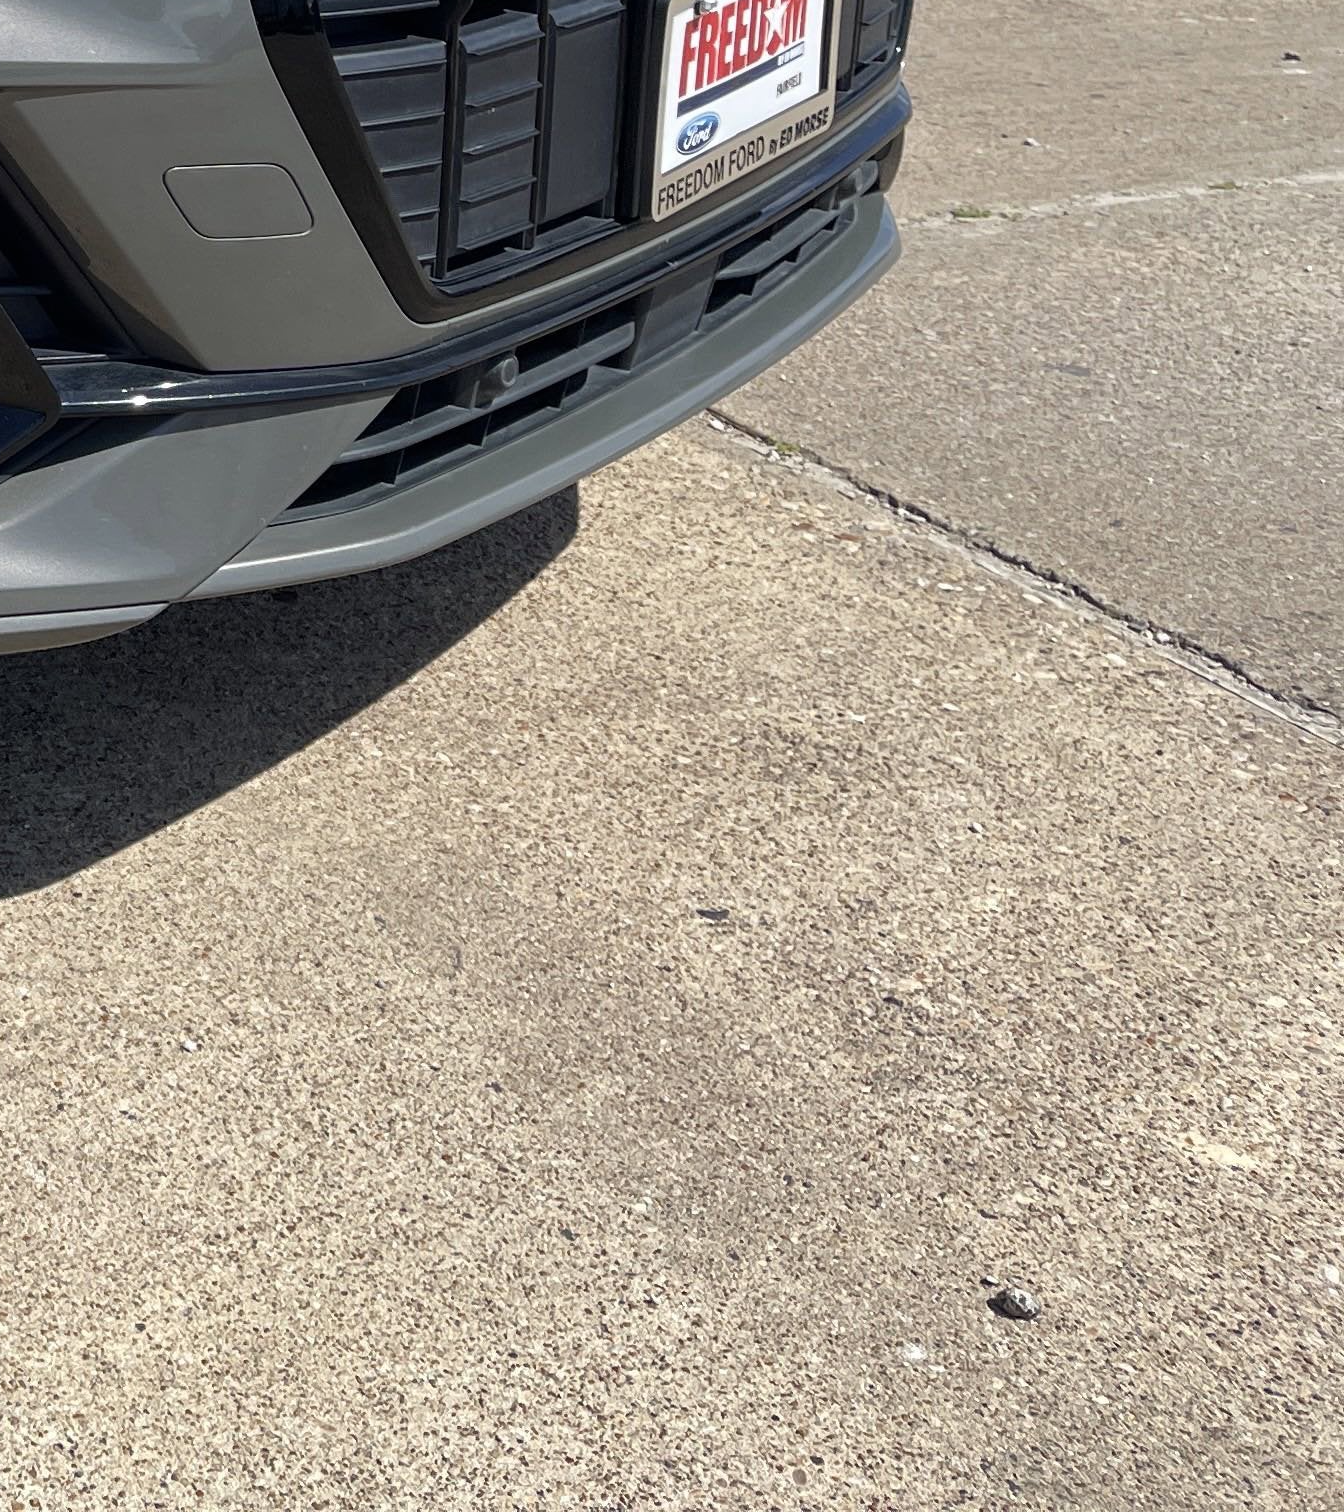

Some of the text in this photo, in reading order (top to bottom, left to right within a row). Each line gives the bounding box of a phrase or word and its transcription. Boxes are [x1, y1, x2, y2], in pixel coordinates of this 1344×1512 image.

[657, 157, 726, 215] FREEDOM
[728, 136, 765, 176] FORD
[779, 124, 794, 150] ED
[794, 106, 830, 140] MORSE
